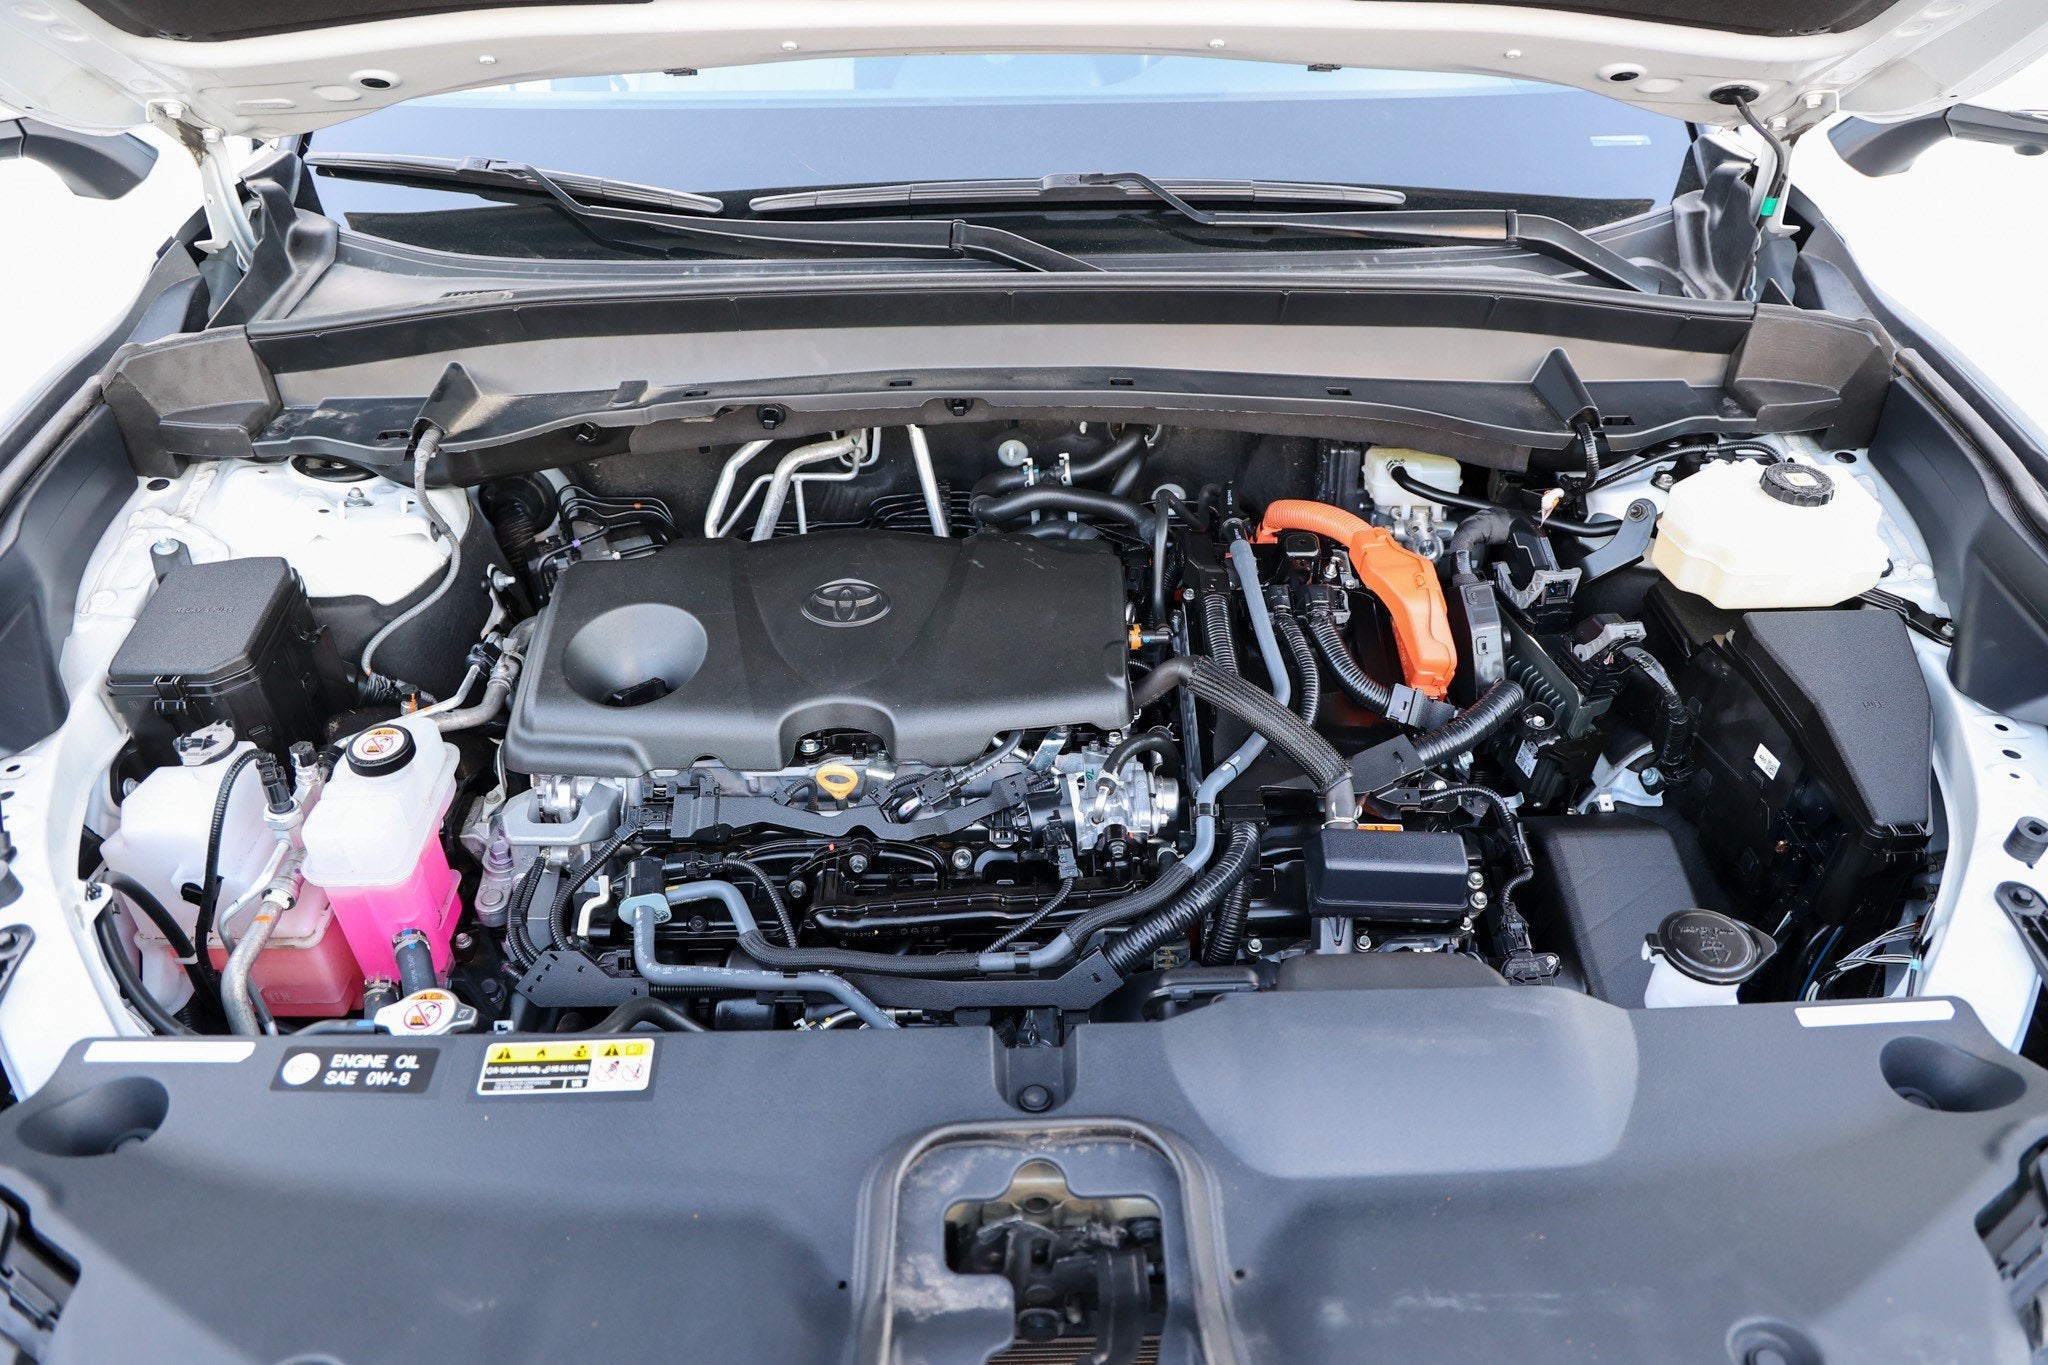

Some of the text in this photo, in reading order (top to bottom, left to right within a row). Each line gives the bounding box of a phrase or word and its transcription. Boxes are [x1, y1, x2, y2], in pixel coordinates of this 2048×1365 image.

[330, 1053, 421, 1069] ENGINE OIL
[323, 1070, 411, 1086] SAE 0W-8
